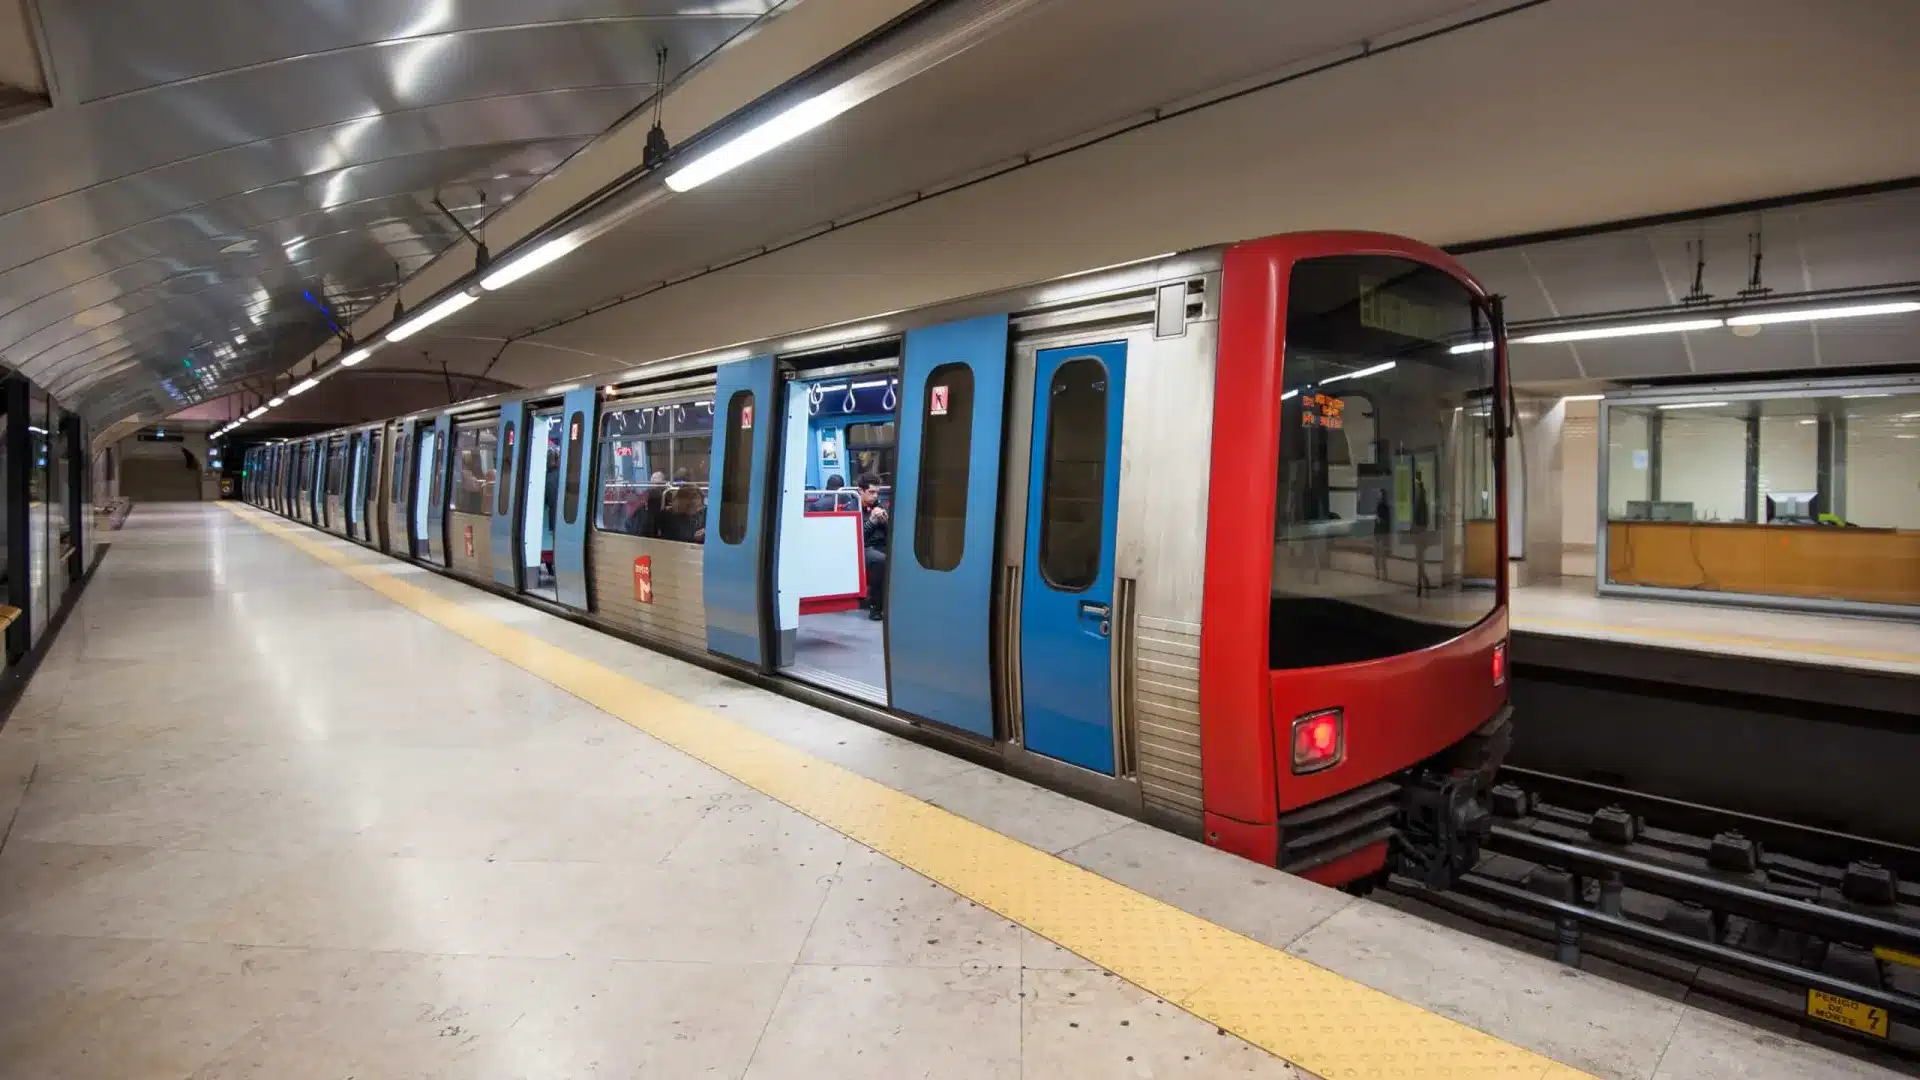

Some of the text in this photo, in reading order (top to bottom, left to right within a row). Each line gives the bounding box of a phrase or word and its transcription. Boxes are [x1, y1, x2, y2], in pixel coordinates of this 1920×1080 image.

[1815, 991, 1859, 1010] PERIGO
[1828, 1003, 1843, 1014] DE
[1815, 1008, 1856, 1026] MORTE
